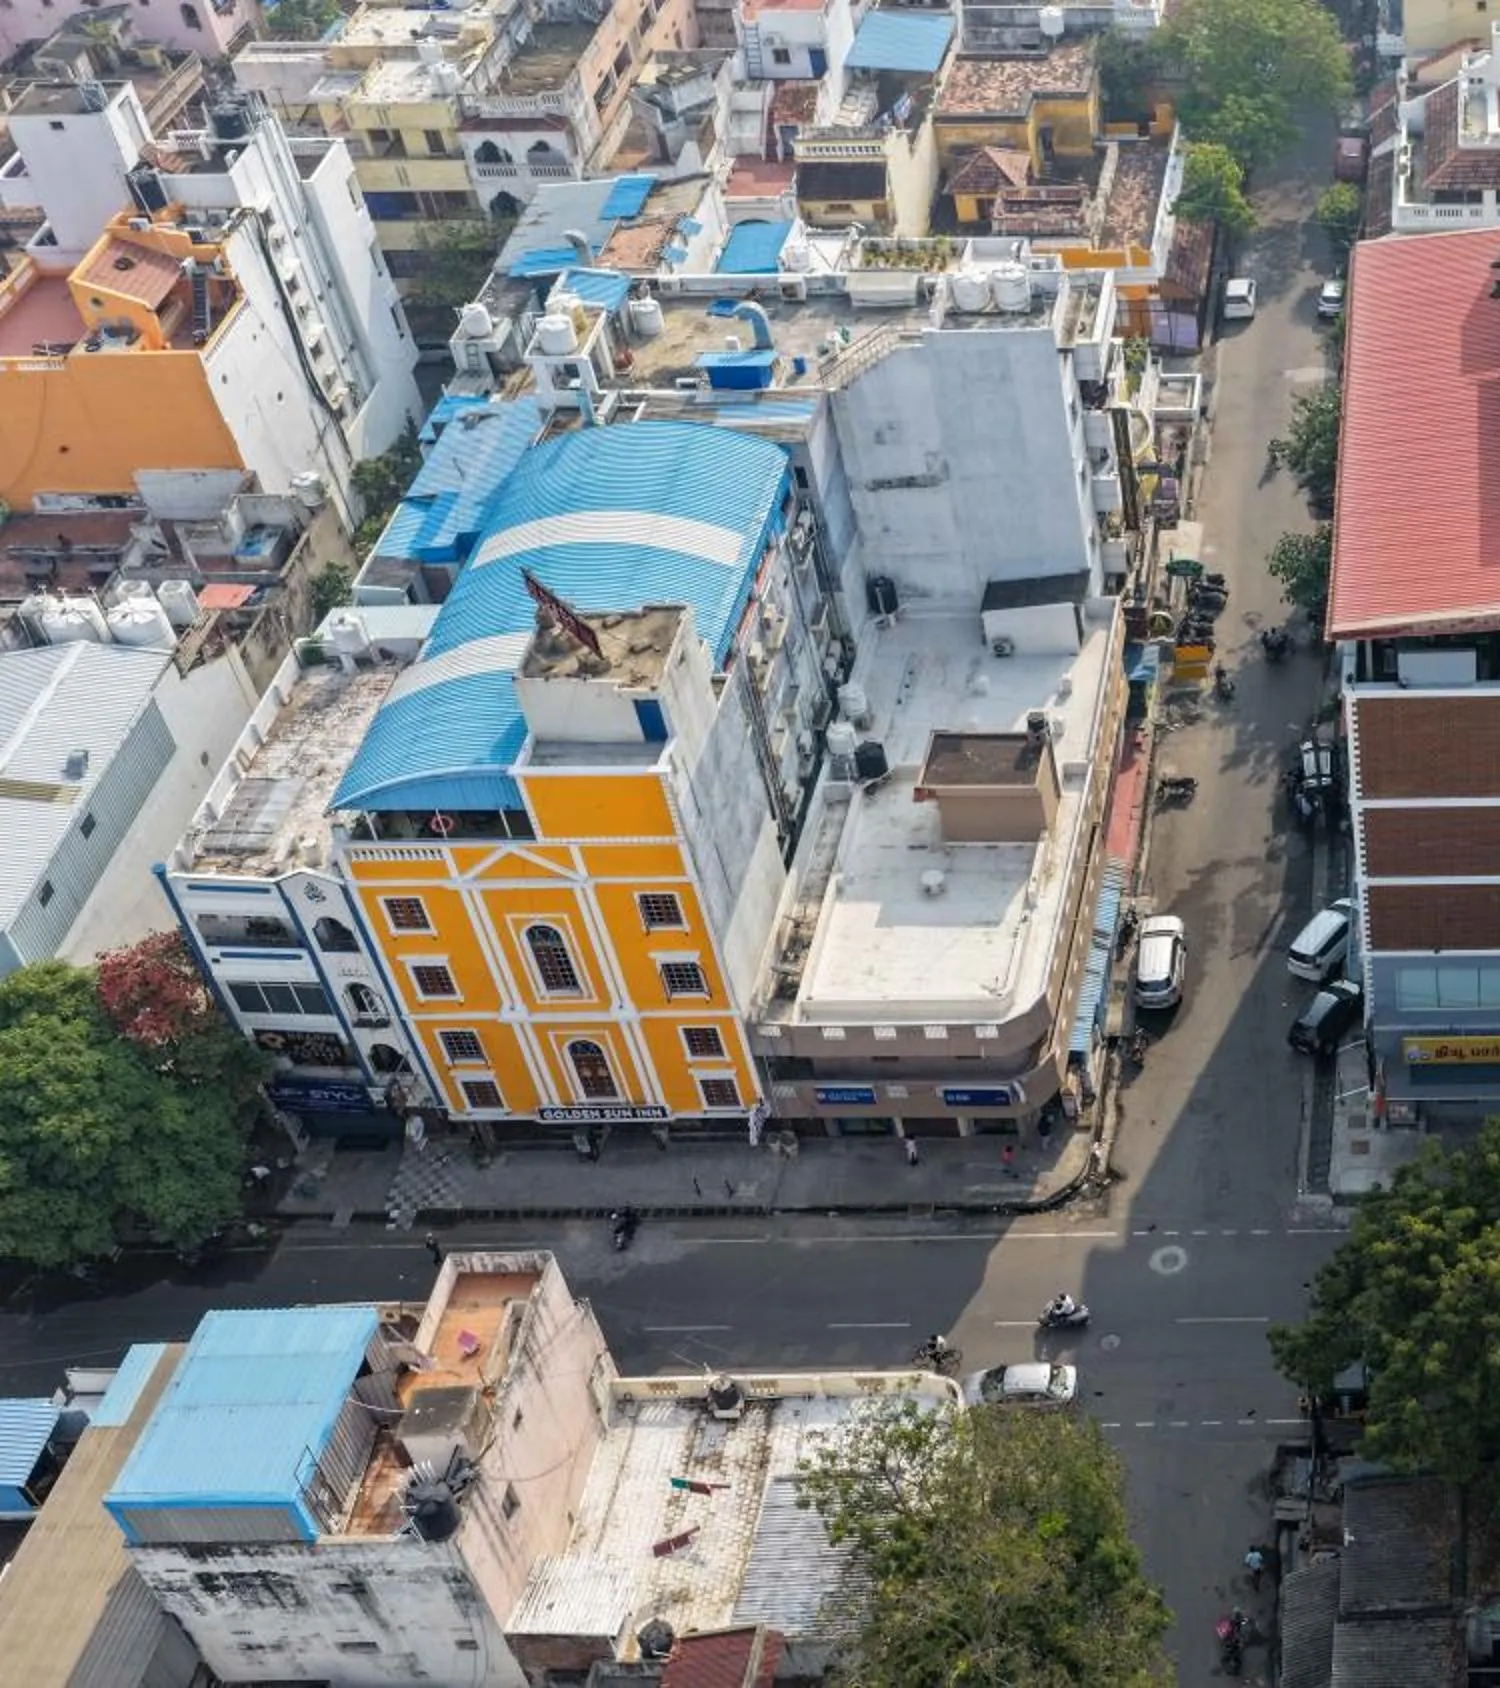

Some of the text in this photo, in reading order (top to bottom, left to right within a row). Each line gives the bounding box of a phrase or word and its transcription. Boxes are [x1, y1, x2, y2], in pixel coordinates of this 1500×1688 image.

[543, 1108, 663, 1120] GOLDEN SUN INN
